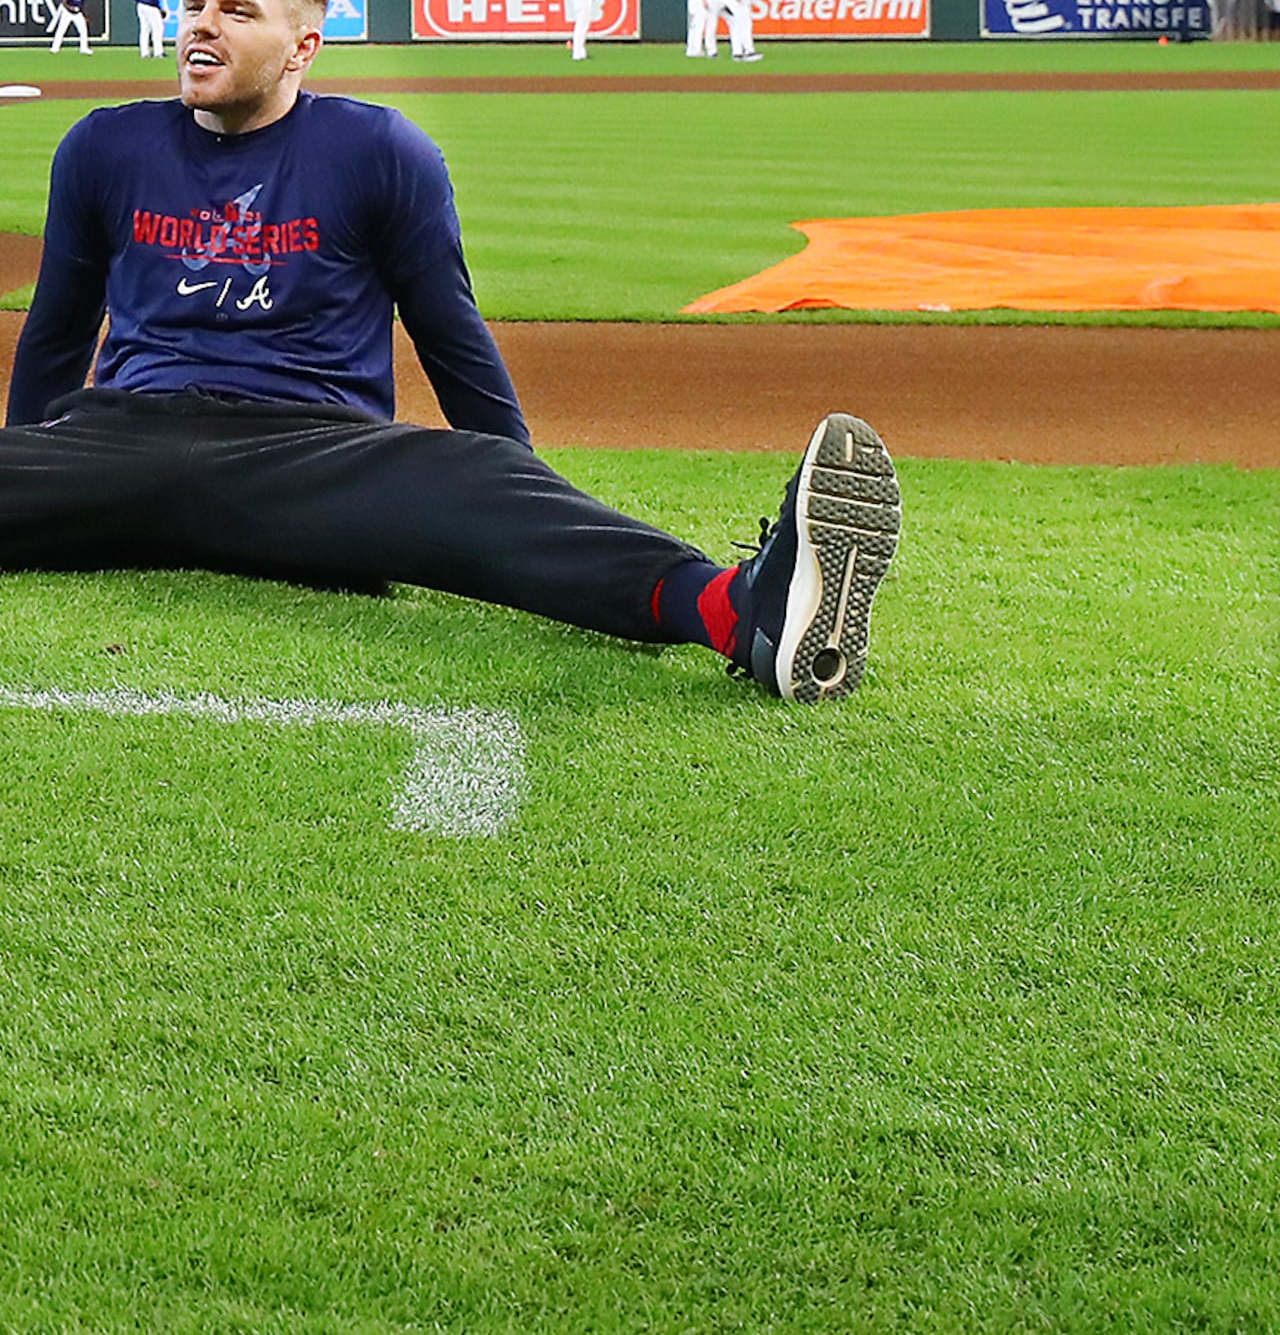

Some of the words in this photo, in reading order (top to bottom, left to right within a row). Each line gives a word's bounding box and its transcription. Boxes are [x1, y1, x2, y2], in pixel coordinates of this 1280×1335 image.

[1076, 6, 1202, 29] TRANSFE
[133, 209, 227, 254] WORLD
[231, 217, 320, 255] SERIES
